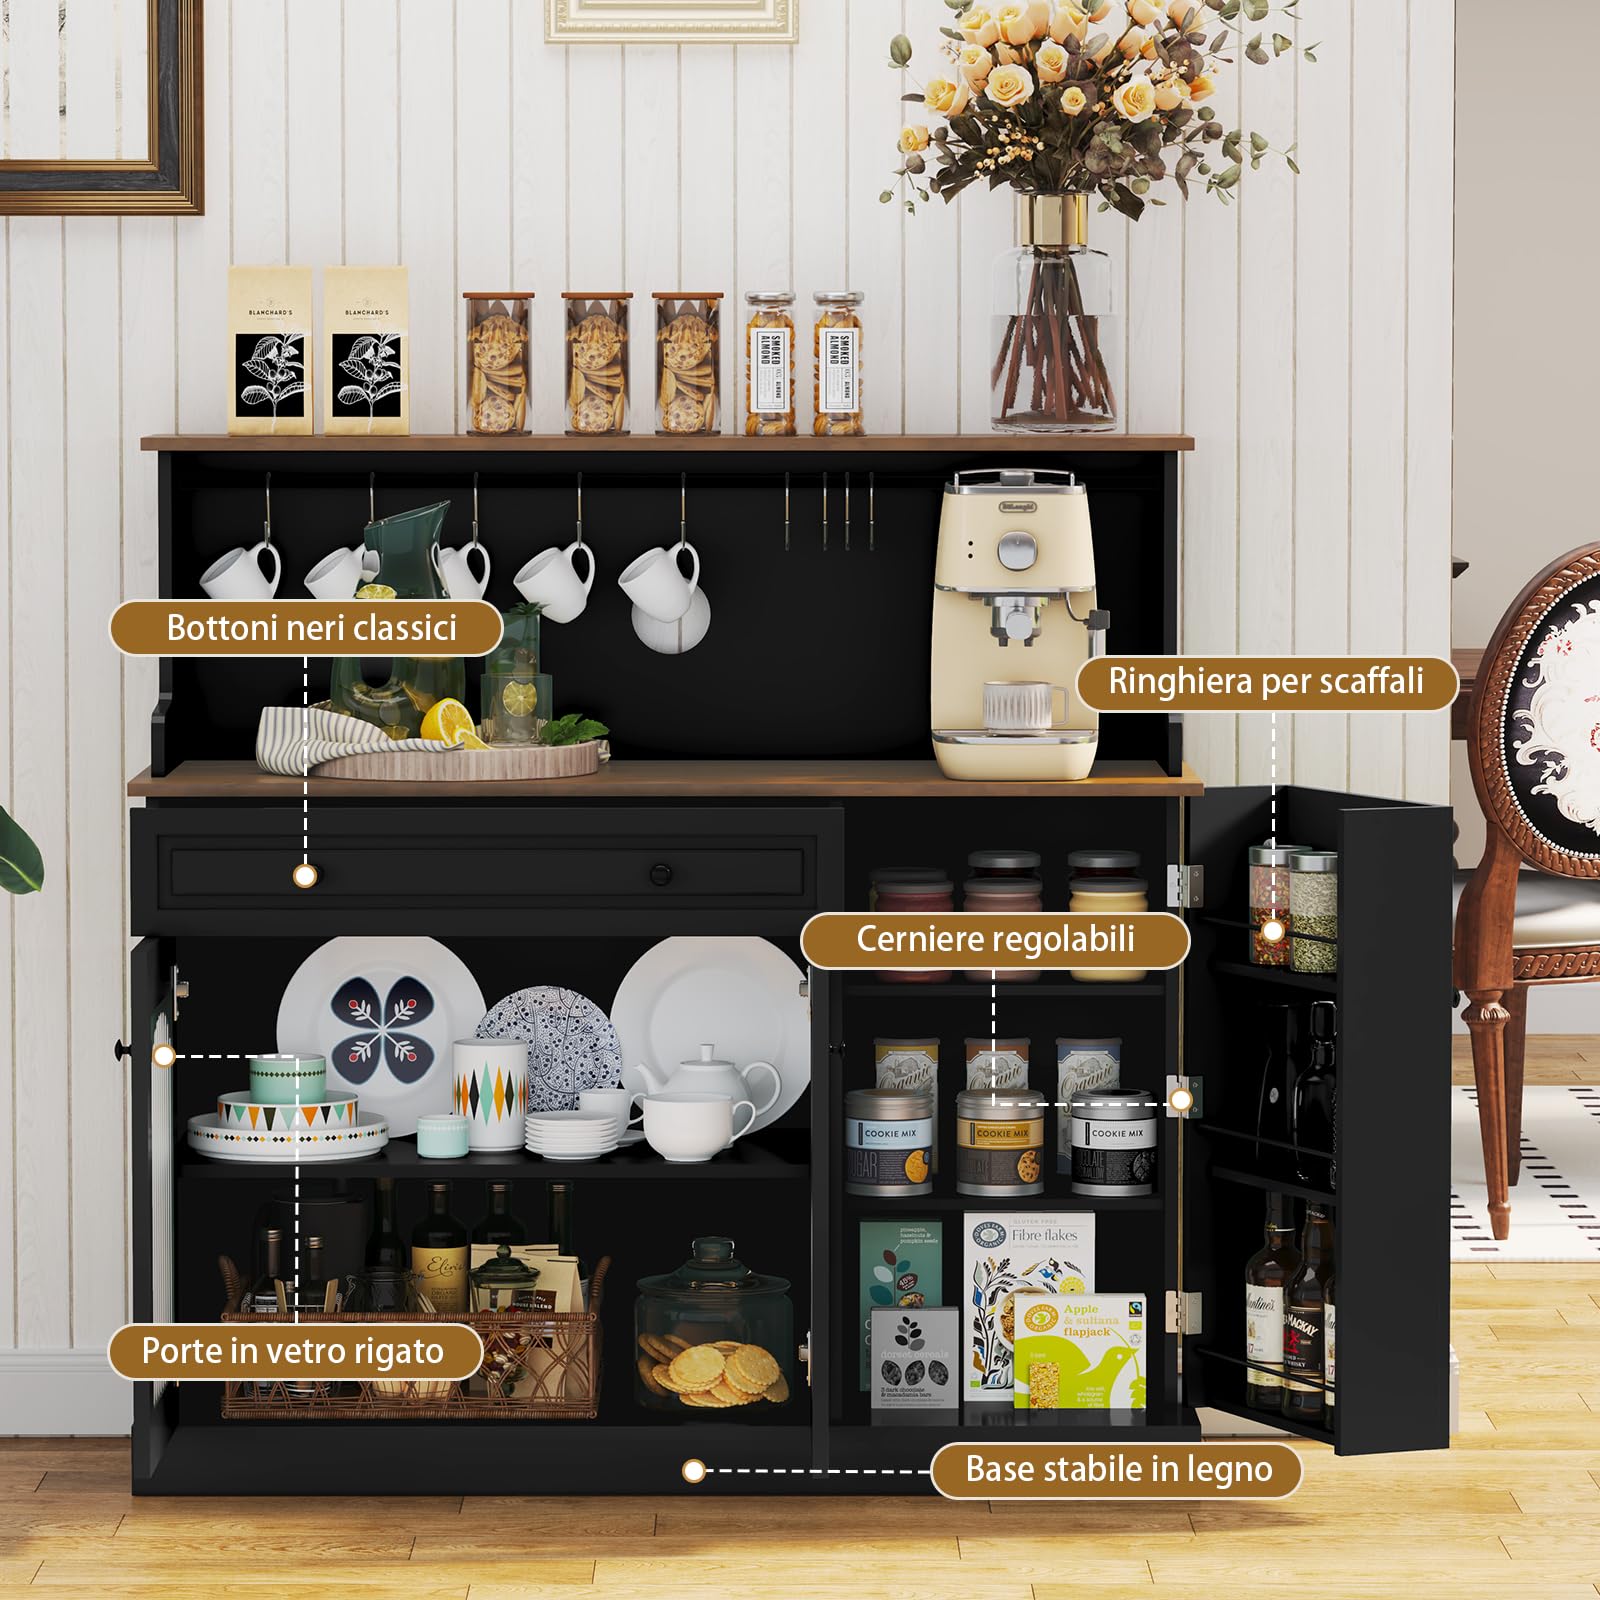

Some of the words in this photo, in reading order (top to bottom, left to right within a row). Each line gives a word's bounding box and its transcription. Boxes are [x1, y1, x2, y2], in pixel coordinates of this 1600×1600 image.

[761, 336, 770, 364] ALMOND
[772, 336, 780, 364] SMOKED
[830, 336, 839, 364] ALMOND
[840, 336, 849, 364] SMOKED
[865, 1130, 899, 1138] COOKIE
[977, 1130, 1011, 1138] COOKIE
[1012, 1228, 1042, 1240] Fibre
[1044, 1228, 1078, 1241] flakes
[976, 1237, 1003, 1247] ORGANIC
[1064, 1304, 1099, 1315] Apple
[1064, 1317, 1073, 1325] &
[1076, 1316, 1120, 1325] sultana
[1288, 1313, 1319, 1337] MACKAY
[1064, 1327, 1111, 1338] flapjack
